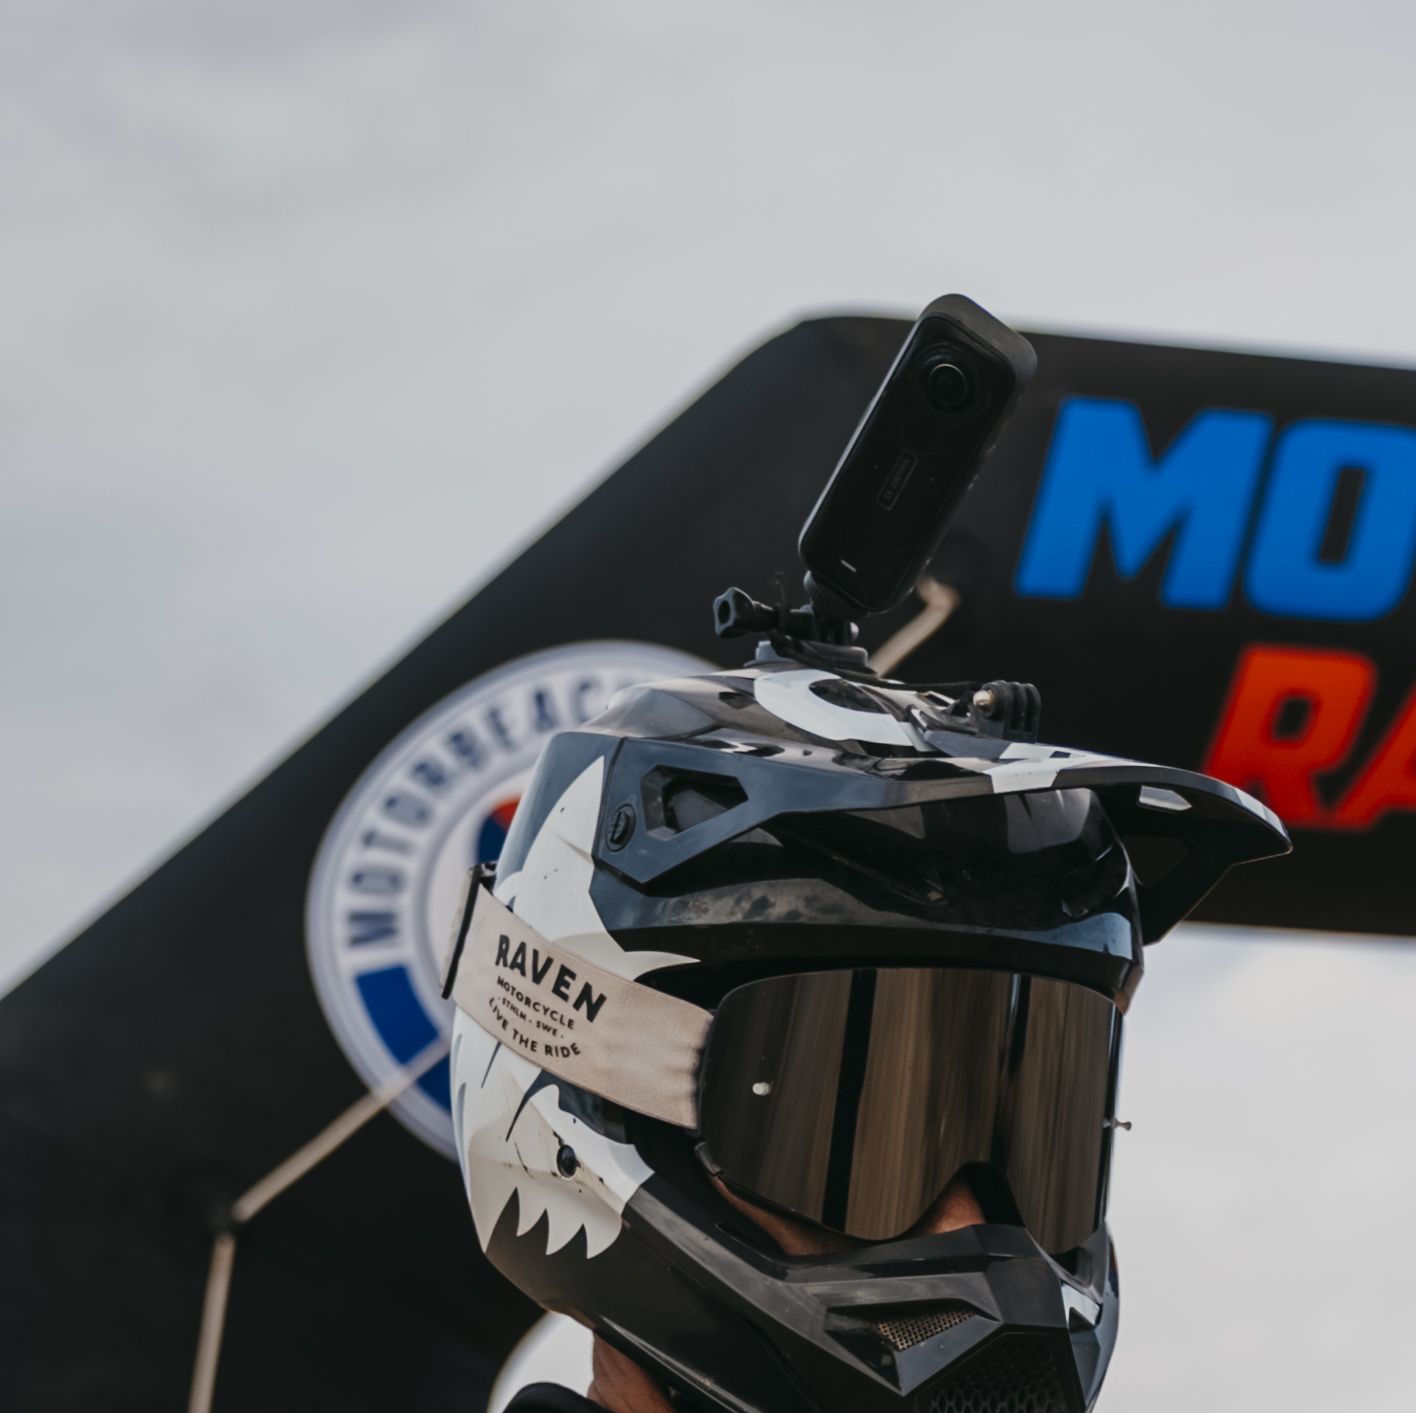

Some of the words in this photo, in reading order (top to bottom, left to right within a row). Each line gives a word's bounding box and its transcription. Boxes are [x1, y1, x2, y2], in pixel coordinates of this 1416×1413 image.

[347, 672, 612, 950] MOTORBEAC
[495, 934, 607, 1023] RAVEN
[497, 976, 575, 1030] MOTORCYCLE
[512, 1028, 538, 1053] THE
[544, 1042, 581, 1058] RIDE
